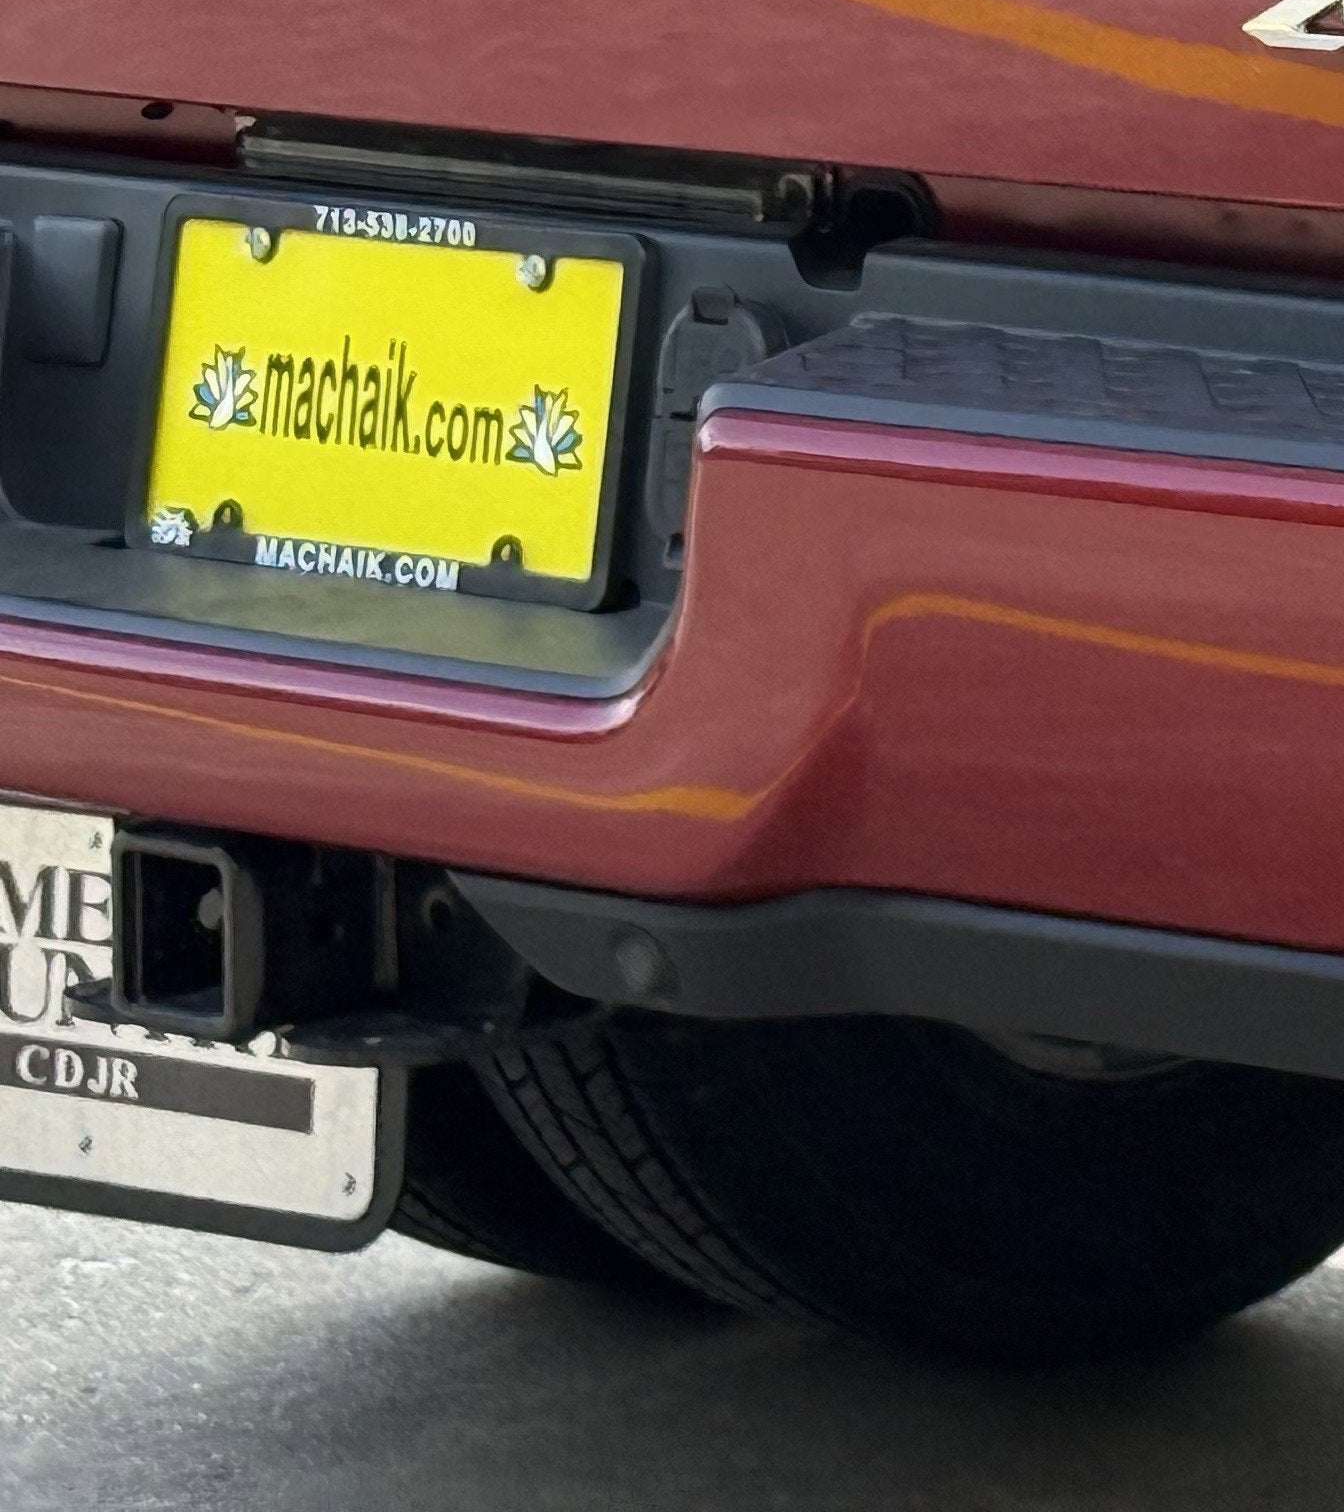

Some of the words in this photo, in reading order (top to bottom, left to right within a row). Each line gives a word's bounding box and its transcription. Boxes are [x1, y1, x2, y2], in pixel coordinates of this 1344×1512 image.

[259, 334, 504, 466] machaik.com
[253, 536, 459, 591] MACHAIK.COM
[15, 1044, 139, 1099] CDJR
